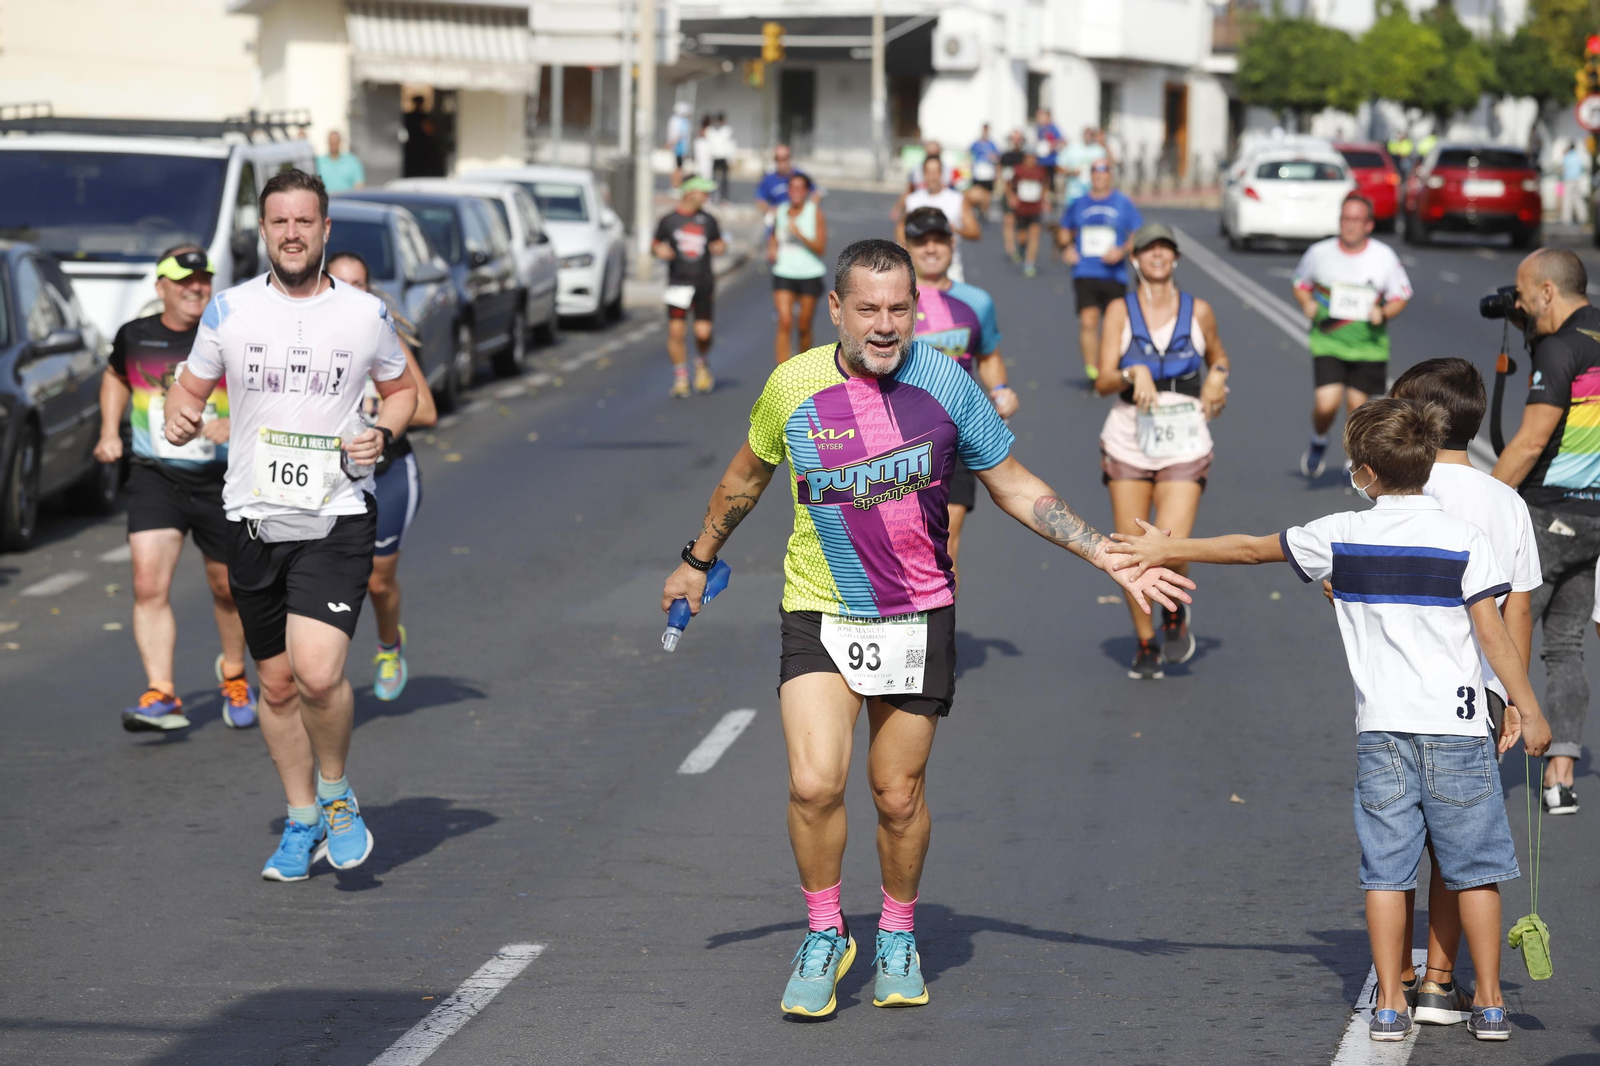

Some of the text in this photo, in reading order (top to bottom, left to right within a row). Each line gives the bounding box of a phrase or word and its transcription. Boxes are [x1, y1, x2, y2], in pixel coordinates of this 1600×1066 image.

[248, 364, 259, 373] XI
[291, 364, 307, 374] VII
[336, 367, 345, 379] V
[271, 433, 300, 447] VUELTA
[301, 437, 308, 448] A
[268, 460, 309, 487] 166
[848, 642, 882, 671] 93
[1456, 685, 1476, 720] 3
